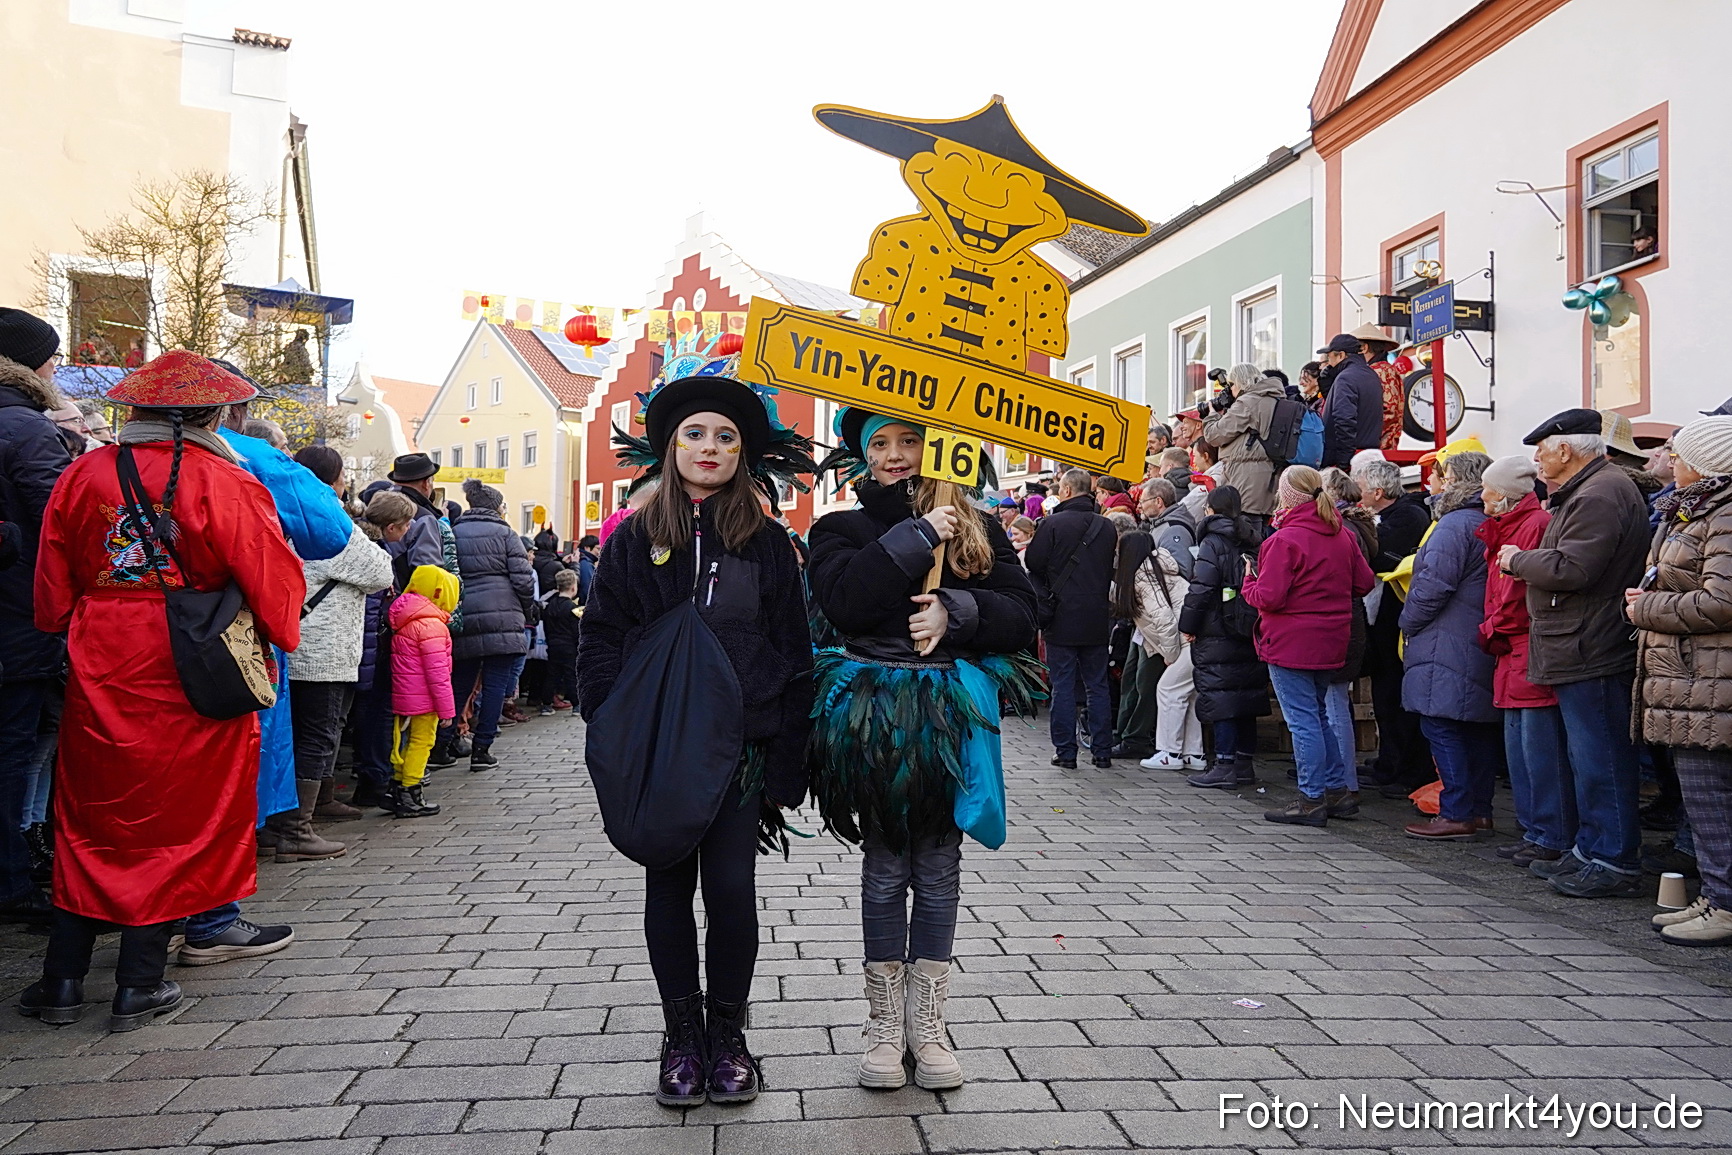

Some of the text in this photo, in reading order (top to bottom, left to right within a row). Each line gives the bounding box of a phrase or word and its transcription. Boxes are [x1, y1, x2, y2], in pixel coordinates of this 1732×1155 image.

[789, 331, 1106, 452] Yin-Yang / Chinesia
[928, 437, 974, 479] 16
